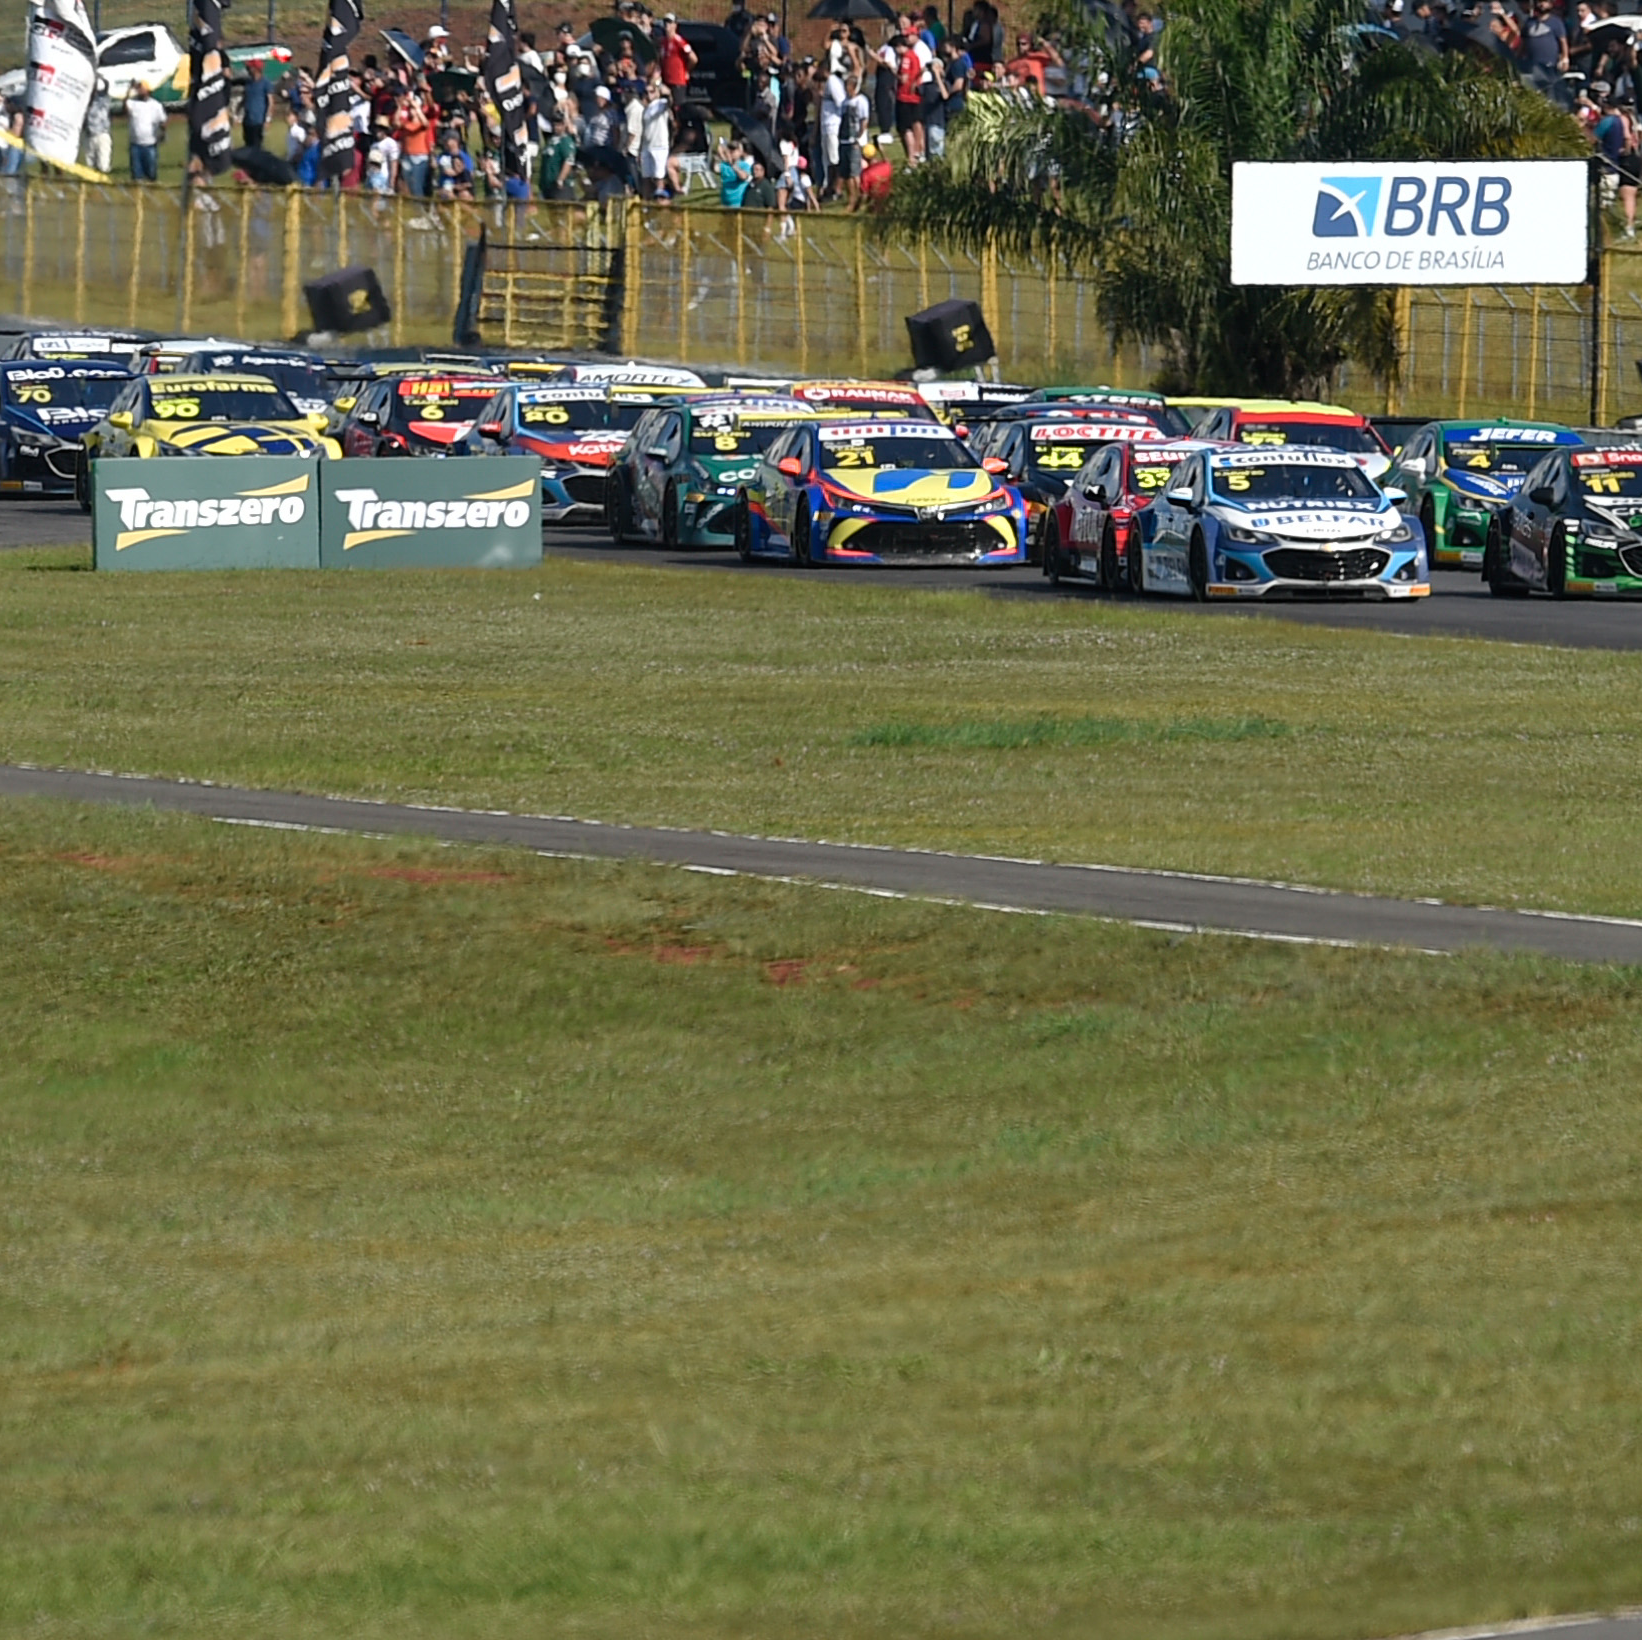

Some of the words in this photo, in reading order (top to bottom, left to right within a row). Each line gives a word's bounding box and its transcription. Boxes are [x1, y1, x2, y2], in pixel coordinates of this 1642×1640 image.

[1383, 176, 1512, 236] BRB
[1306, 251, 1381, 270] BANCO
[1385, 251, 1413, 270] DE
[1419, 245, 1505, 270] BRASÍLIA
[579, 372, 691, 385] AMORTEX
[150, 380, 278, 394] Eurofarma
[16, 389, 53, 403] 70
[154, 402, 201, 419] 90
[420, 404, 445, 420] 6
[1034, 426, 1158, 440] LOCTITE
[1469, 427, 1557, 442] JEFER
[714, 435, 738, 451] 8
[834, 450, 875, 467] 21
[1036, 451, 1084, 467] 44
[1235, 452, 1348, 466] contuflex
[1466, 454, 1492, 468] 4
[1227, 475, 1251, 491] 5
[1585, 477, 1621, 493] 11
[105, 487, 305, 531] Transzero
[333, 487, 531, 531] Transzero
[1246, 499, 1376, 511] NUTRIEX
[1276, 513, 1385, 527] BELFAR
